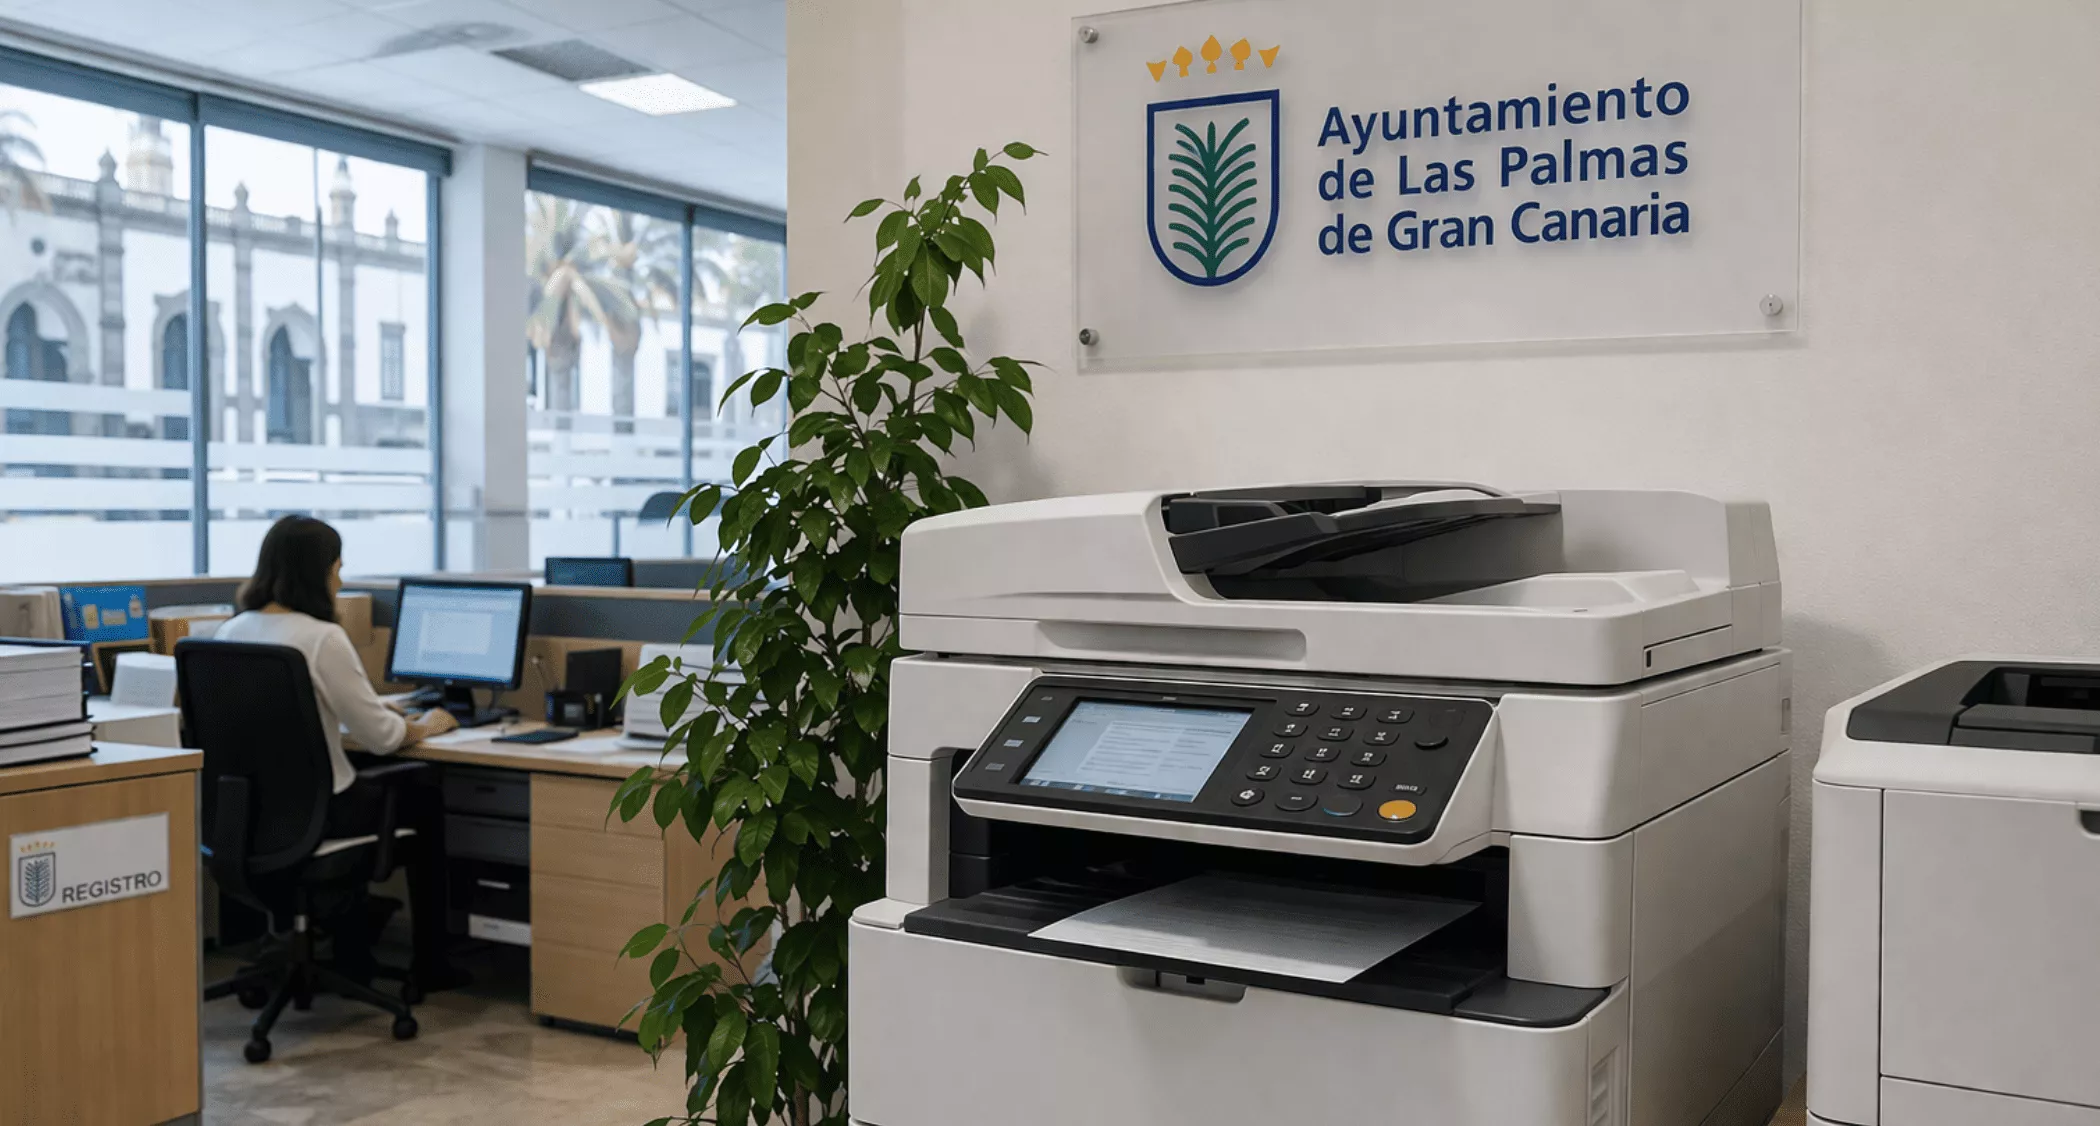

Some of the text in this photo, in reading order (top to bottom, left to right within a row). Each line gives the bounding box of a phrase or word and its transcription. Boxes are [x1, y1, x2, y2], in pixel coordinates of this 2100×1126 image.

[1317, 76, 1690, 156] Ayuntamiento
[1318, 138, 1688, 202] de Las Palmas
[1318, 191, 1690, 256] de Gran Canaria
[61, 870, 162, 904] REGISTRO
